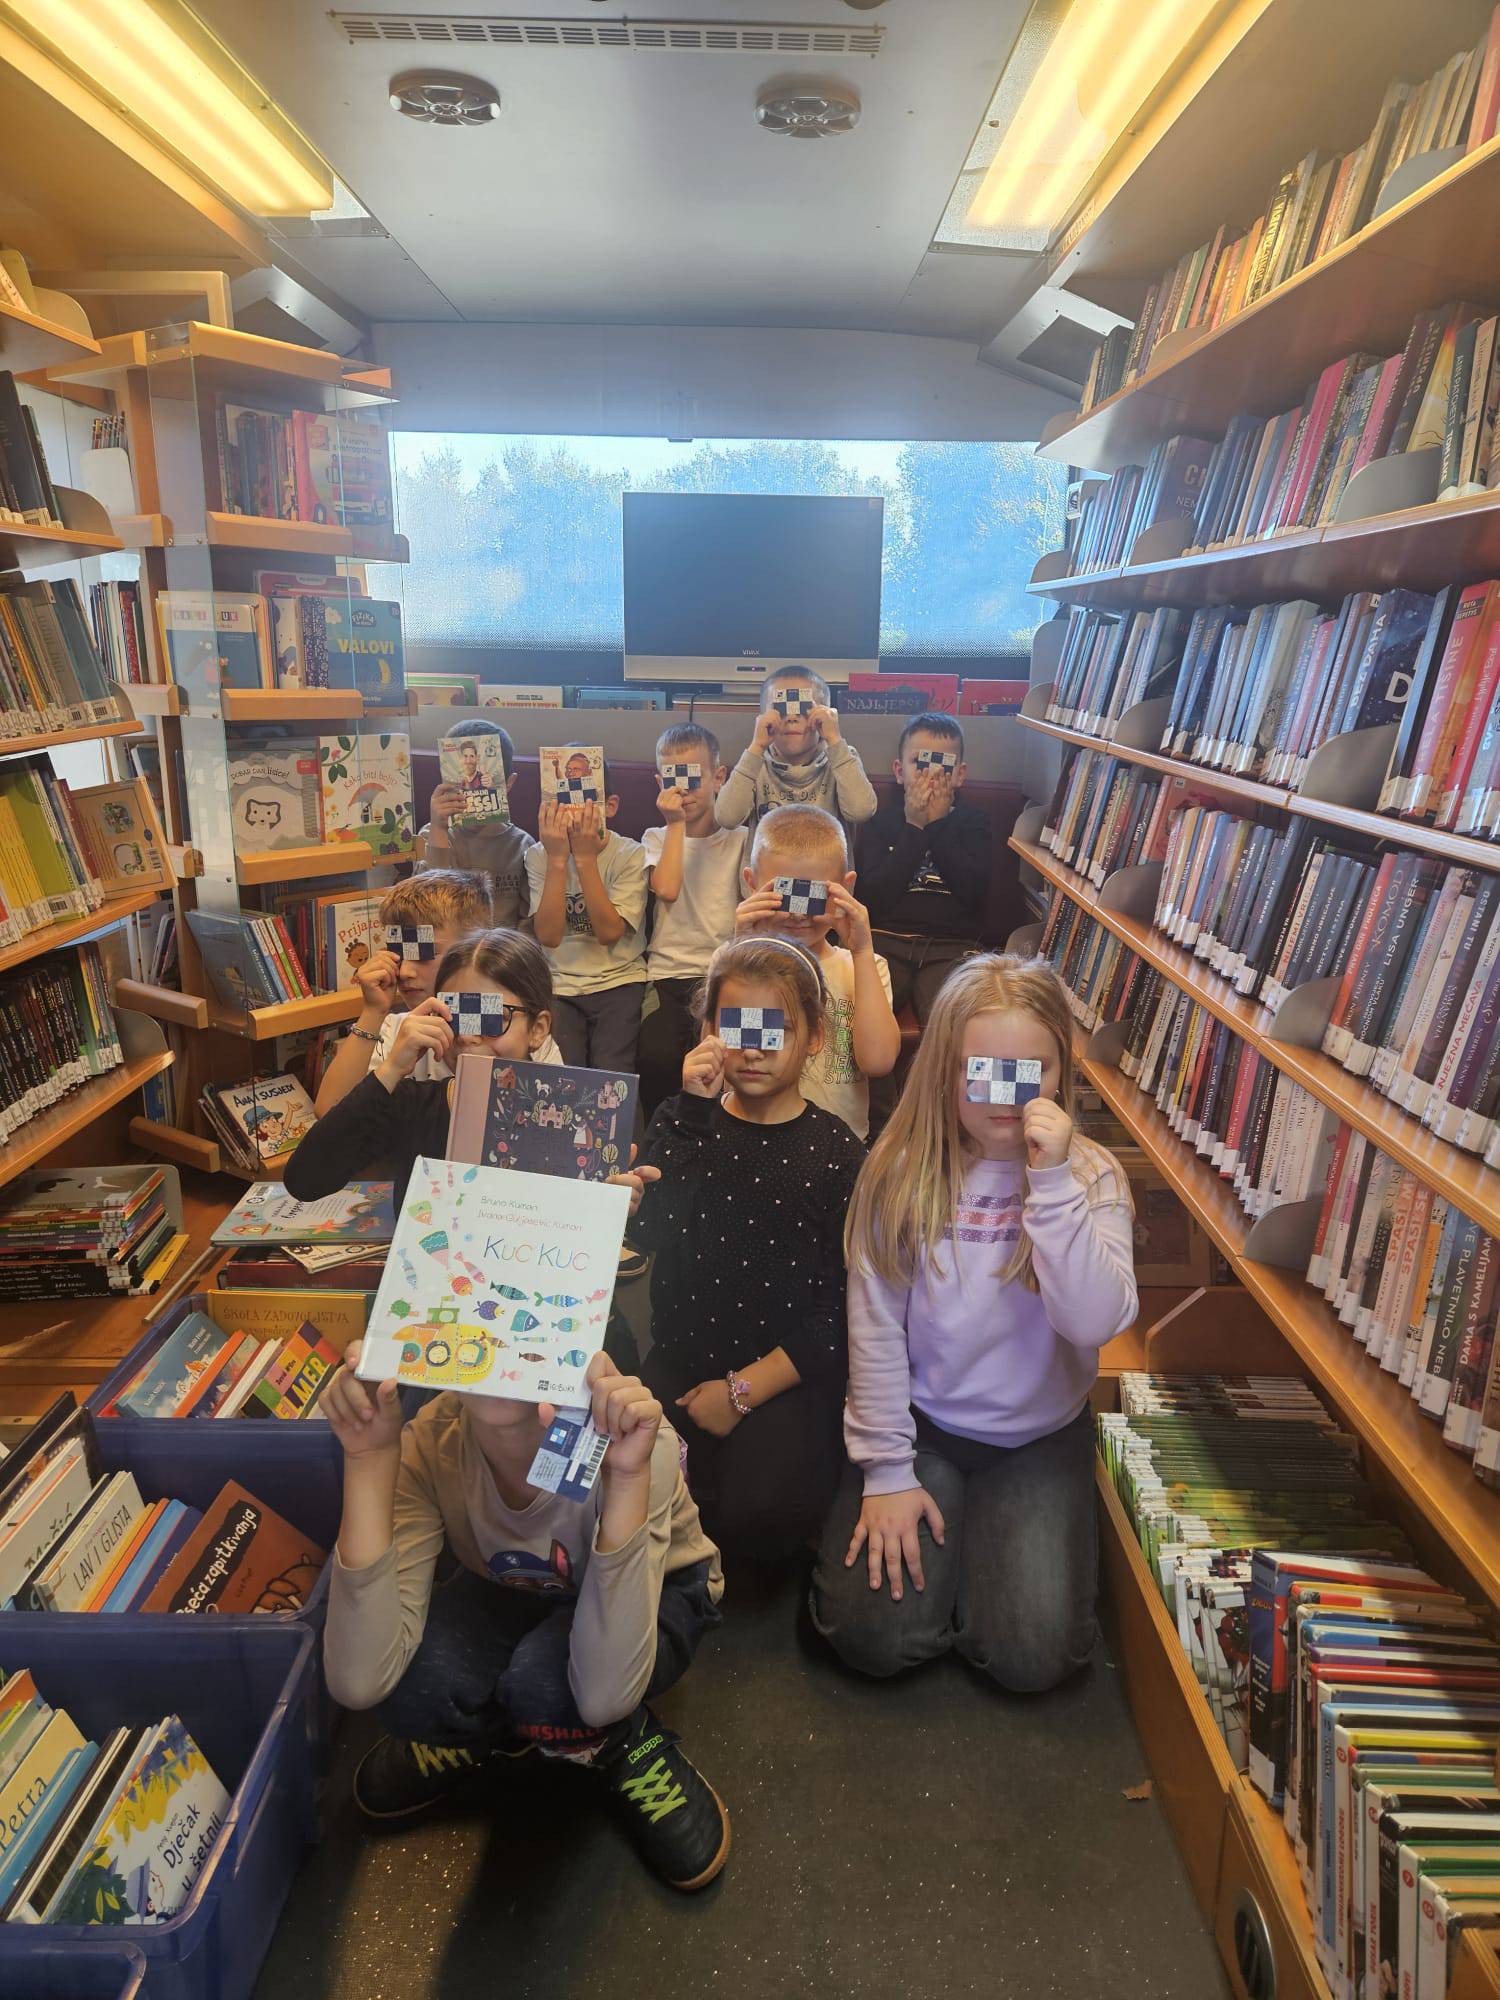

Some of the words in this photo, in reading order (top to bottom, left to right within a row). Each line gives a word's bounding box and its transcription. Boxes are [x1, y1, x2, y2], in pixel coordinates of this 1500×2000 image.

[338, 638, 395, 655] VALOVI
[1365, 612, 1387, 669] DAHA
[1384, 934, 1401, 967] LISA
[1397, 878, 1420, 930] UNGER
[1471, 890, 1491, 935] OSTANI
[1463, 935, 1474, 951] TU
[259, 1083, 297, 1101] SUSJEDI
[480, 1195, 507, 1209] Bruno
[508, 1199, 539, 1211] Kuman
[483, 1235, 533, 1263] KUC
[537, 1243, 590, 1271] KUC
[1386, 1208, 1408, 1263] SPASI
[1401, 1218, 1423, 1276] SPASI
[1441, 1246, 1473, 1339] PLAVETNILO
[1473, 1236, 1493, 1310] KAMELIJAM
[223, 1307, 260, 1320] ŠKOLA
[1468, 1311, 1479, 1322] S
[1432, 1343, 1446, 1376] NEB
[1459, 1325, 1477, 1365] DAMA
[273, 1356, 327, 1418] ELMER
[73, 1553, 96, 1592] LAV
[93, 1545, 102, 1566] I
[100, 1504, 133, 1553] GLISTA
[204, 1508, 257, 1586] zapitkivanja
[627, 1734, 664, 1764] Kappa
[163, 1802, 201, 1869] Dječak
[181, 1874, 193, 1892] u
